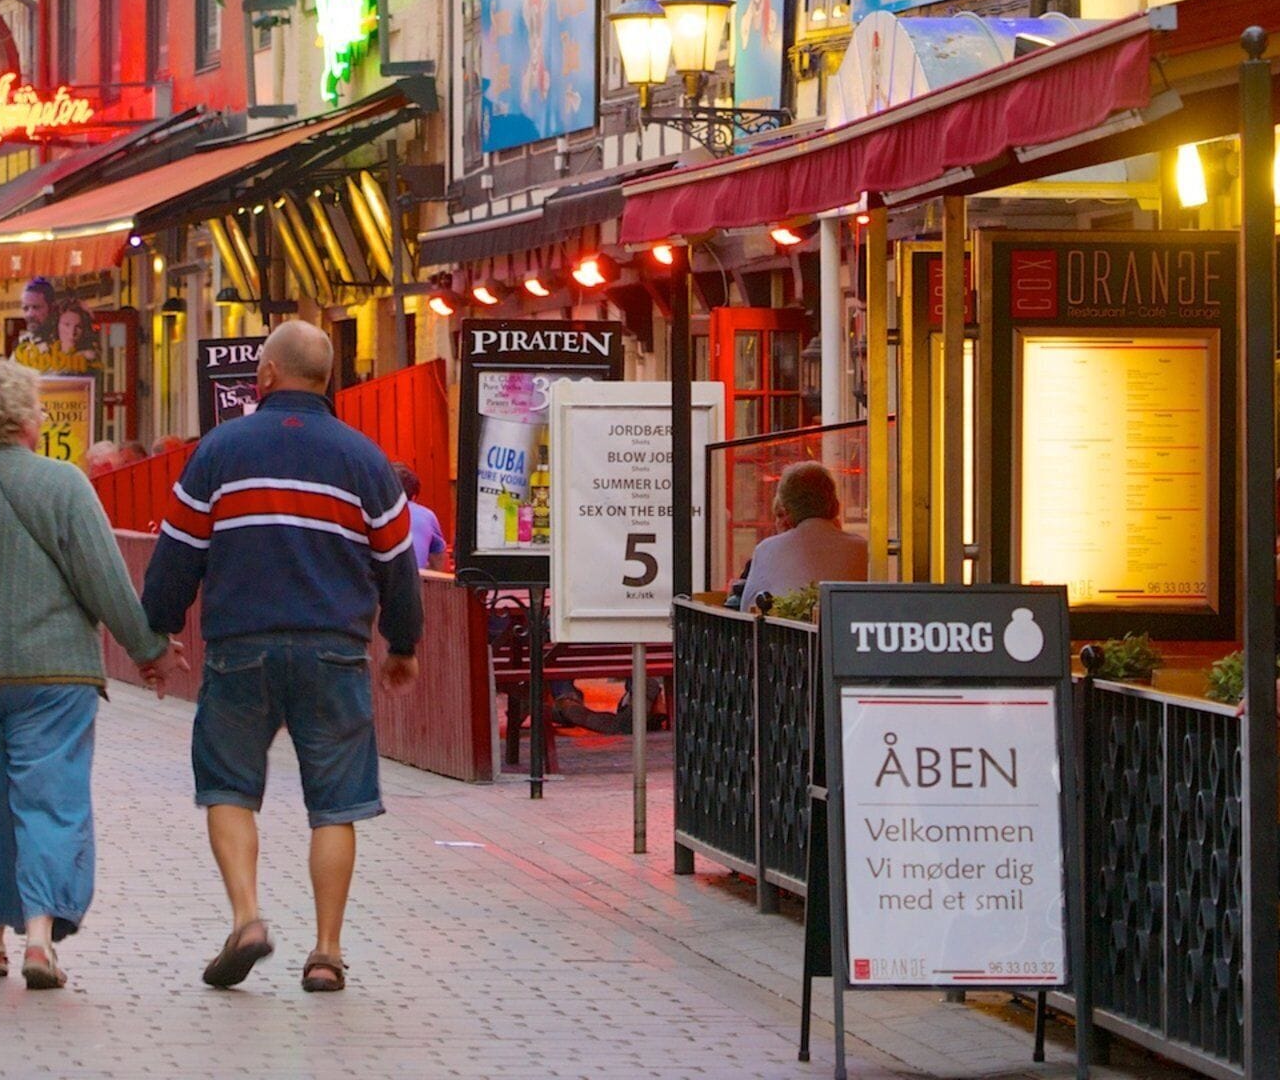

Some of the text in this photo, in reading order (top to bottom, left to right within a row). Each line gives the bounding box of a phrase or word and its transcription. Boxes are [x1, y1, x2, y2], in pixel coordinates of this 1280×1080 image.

[1067, 250, 1220, 305] ORANGE
[205, 345, 264, 368] PIRA
[471, 330, 613, 357] PIRATEN
[42, 398, 87, 410] UBORG
[42, 428, 72, 461] 15
[608, 451, 646, 464] BLOW
[487, 445, 526, 474] CUBA
[593, 478, 651, 490] SUMMER
[579, 505, 702, 518] SEX ON THE BEH
[621, 533, 659, 589] 5
[1148, 582, 1160, 594] 96
[1163, 582, 1176, 594] 33
[1178, 582, 1191, 594] 03
[1194, 581, 1206, 593] 32
[850, 622, 994, 653] TUBORG
[875, 732, 1018, 788] ÅBEN
[864, 817, 1034, 844] Velkommen
[866, 856, 1034, 886] Vi møder dig
[879, 888, 1024, 911] med et smil
[1006, 962, 1020, 974] 33
[1023, 962, 1038, 974] 03
[1041, 962, 1055, 974] 32
